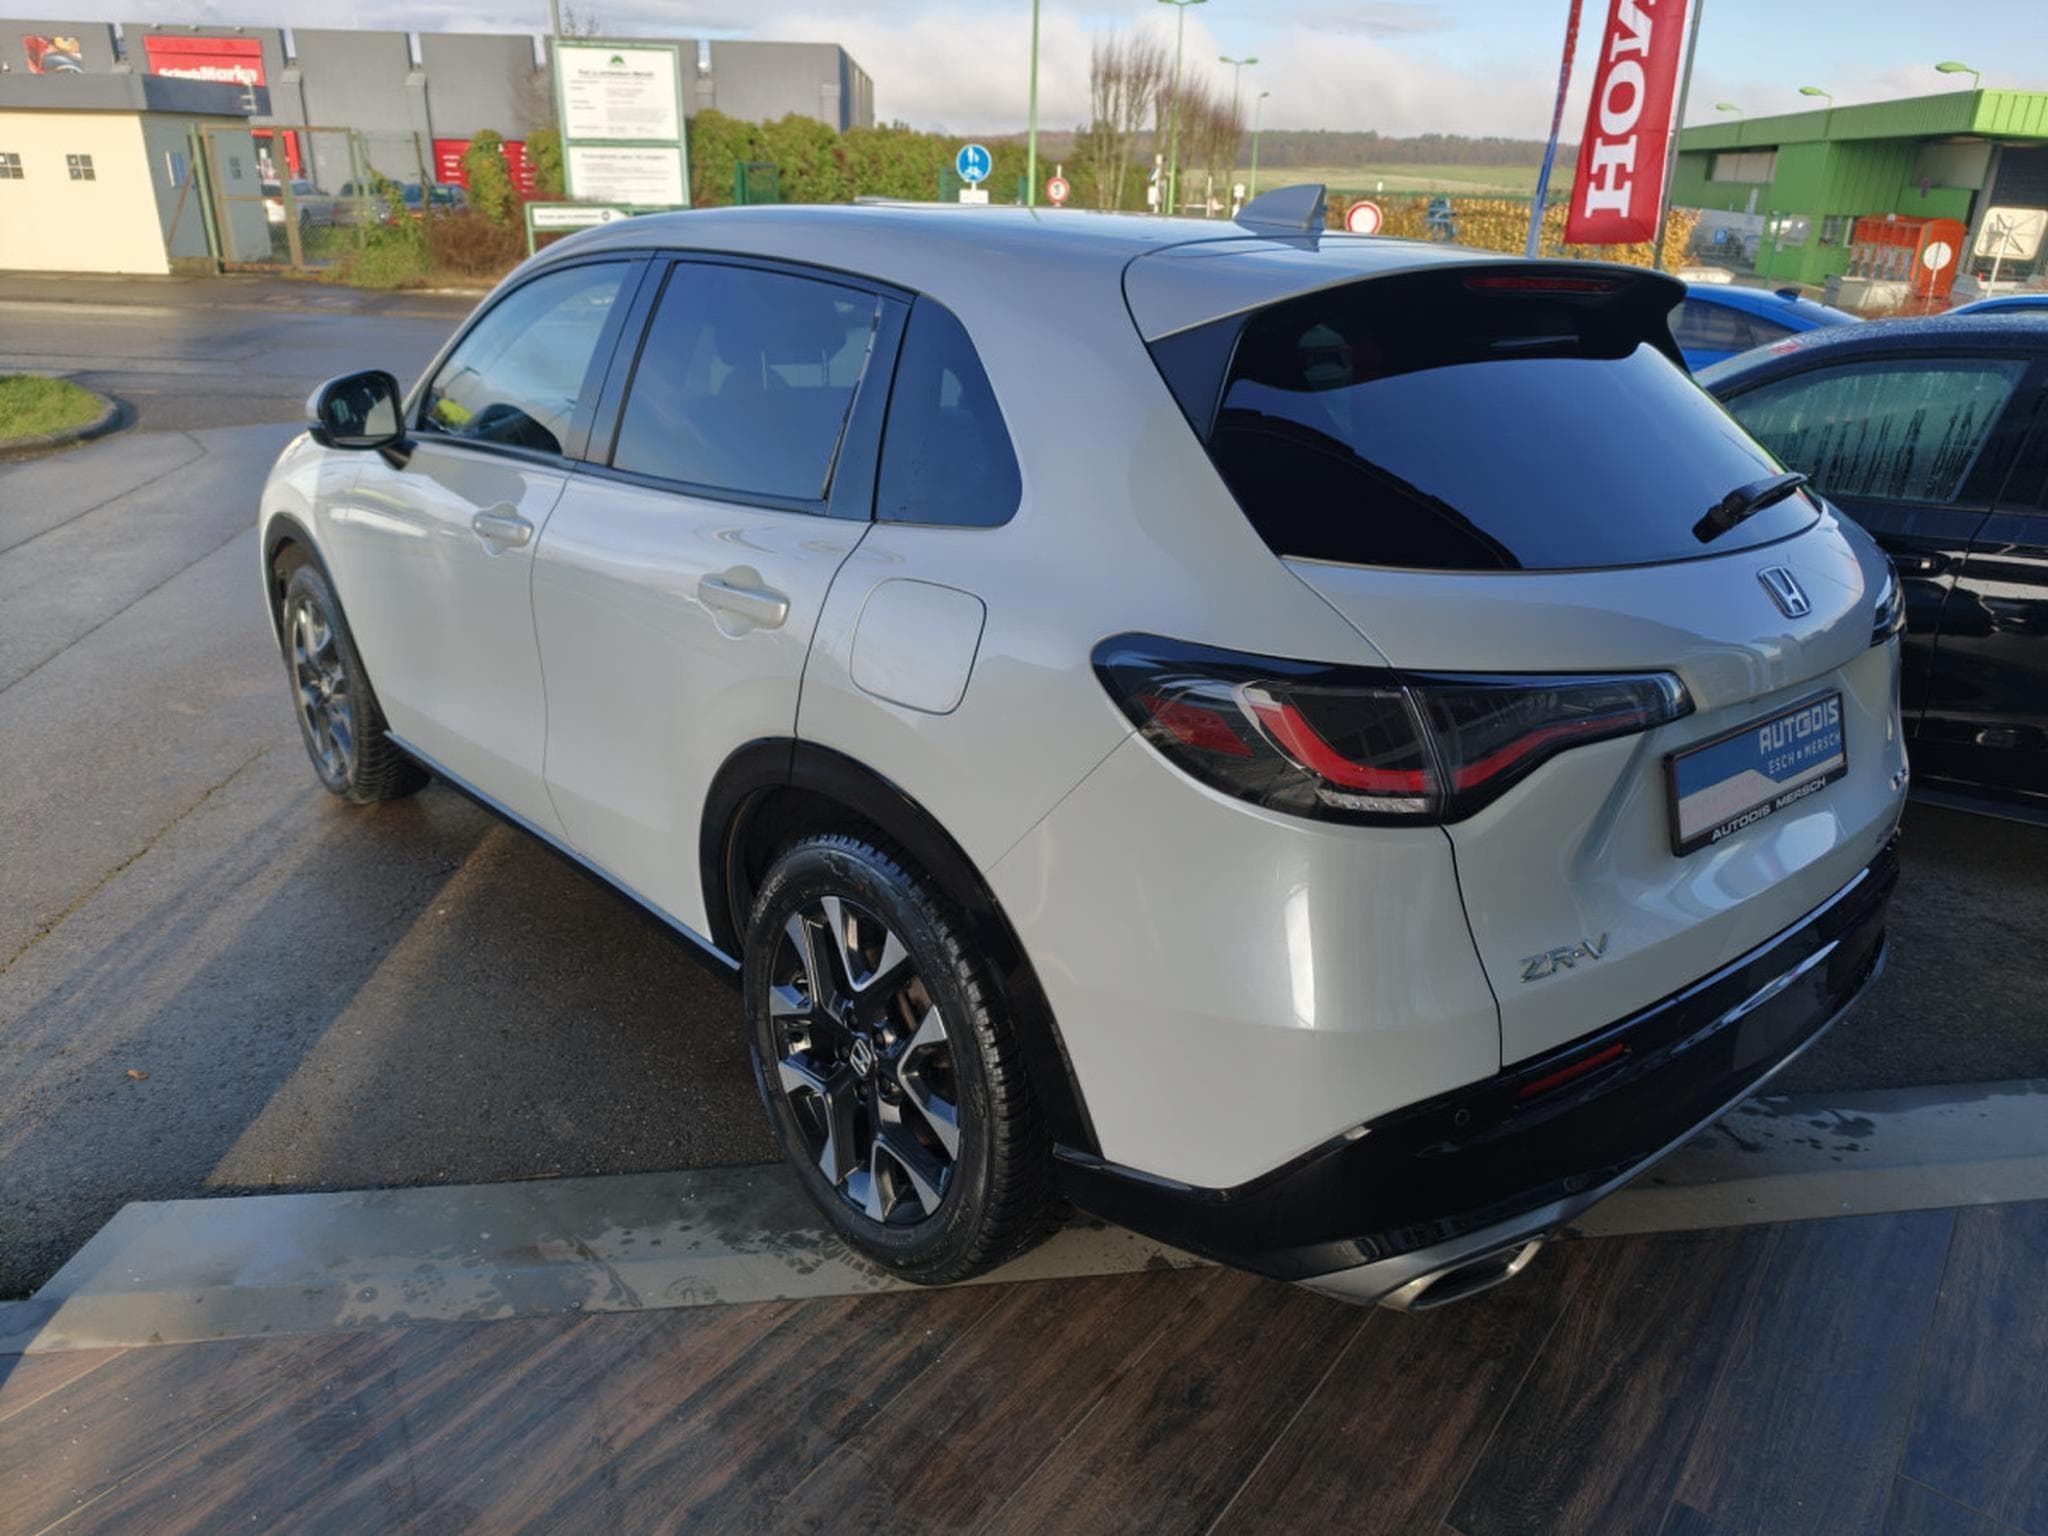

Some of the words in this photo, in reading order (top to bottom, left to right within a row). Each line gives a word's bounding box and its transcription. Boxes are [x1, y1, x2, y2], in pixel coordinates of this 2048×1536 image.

[1759, 697, 1839, 756] AUTODIS
[1768, 751, 1795, 775] ESCH
[1712, 804, 1771, 842] AUTODIS
[1775, 776, 1826, 809] MERSCH
